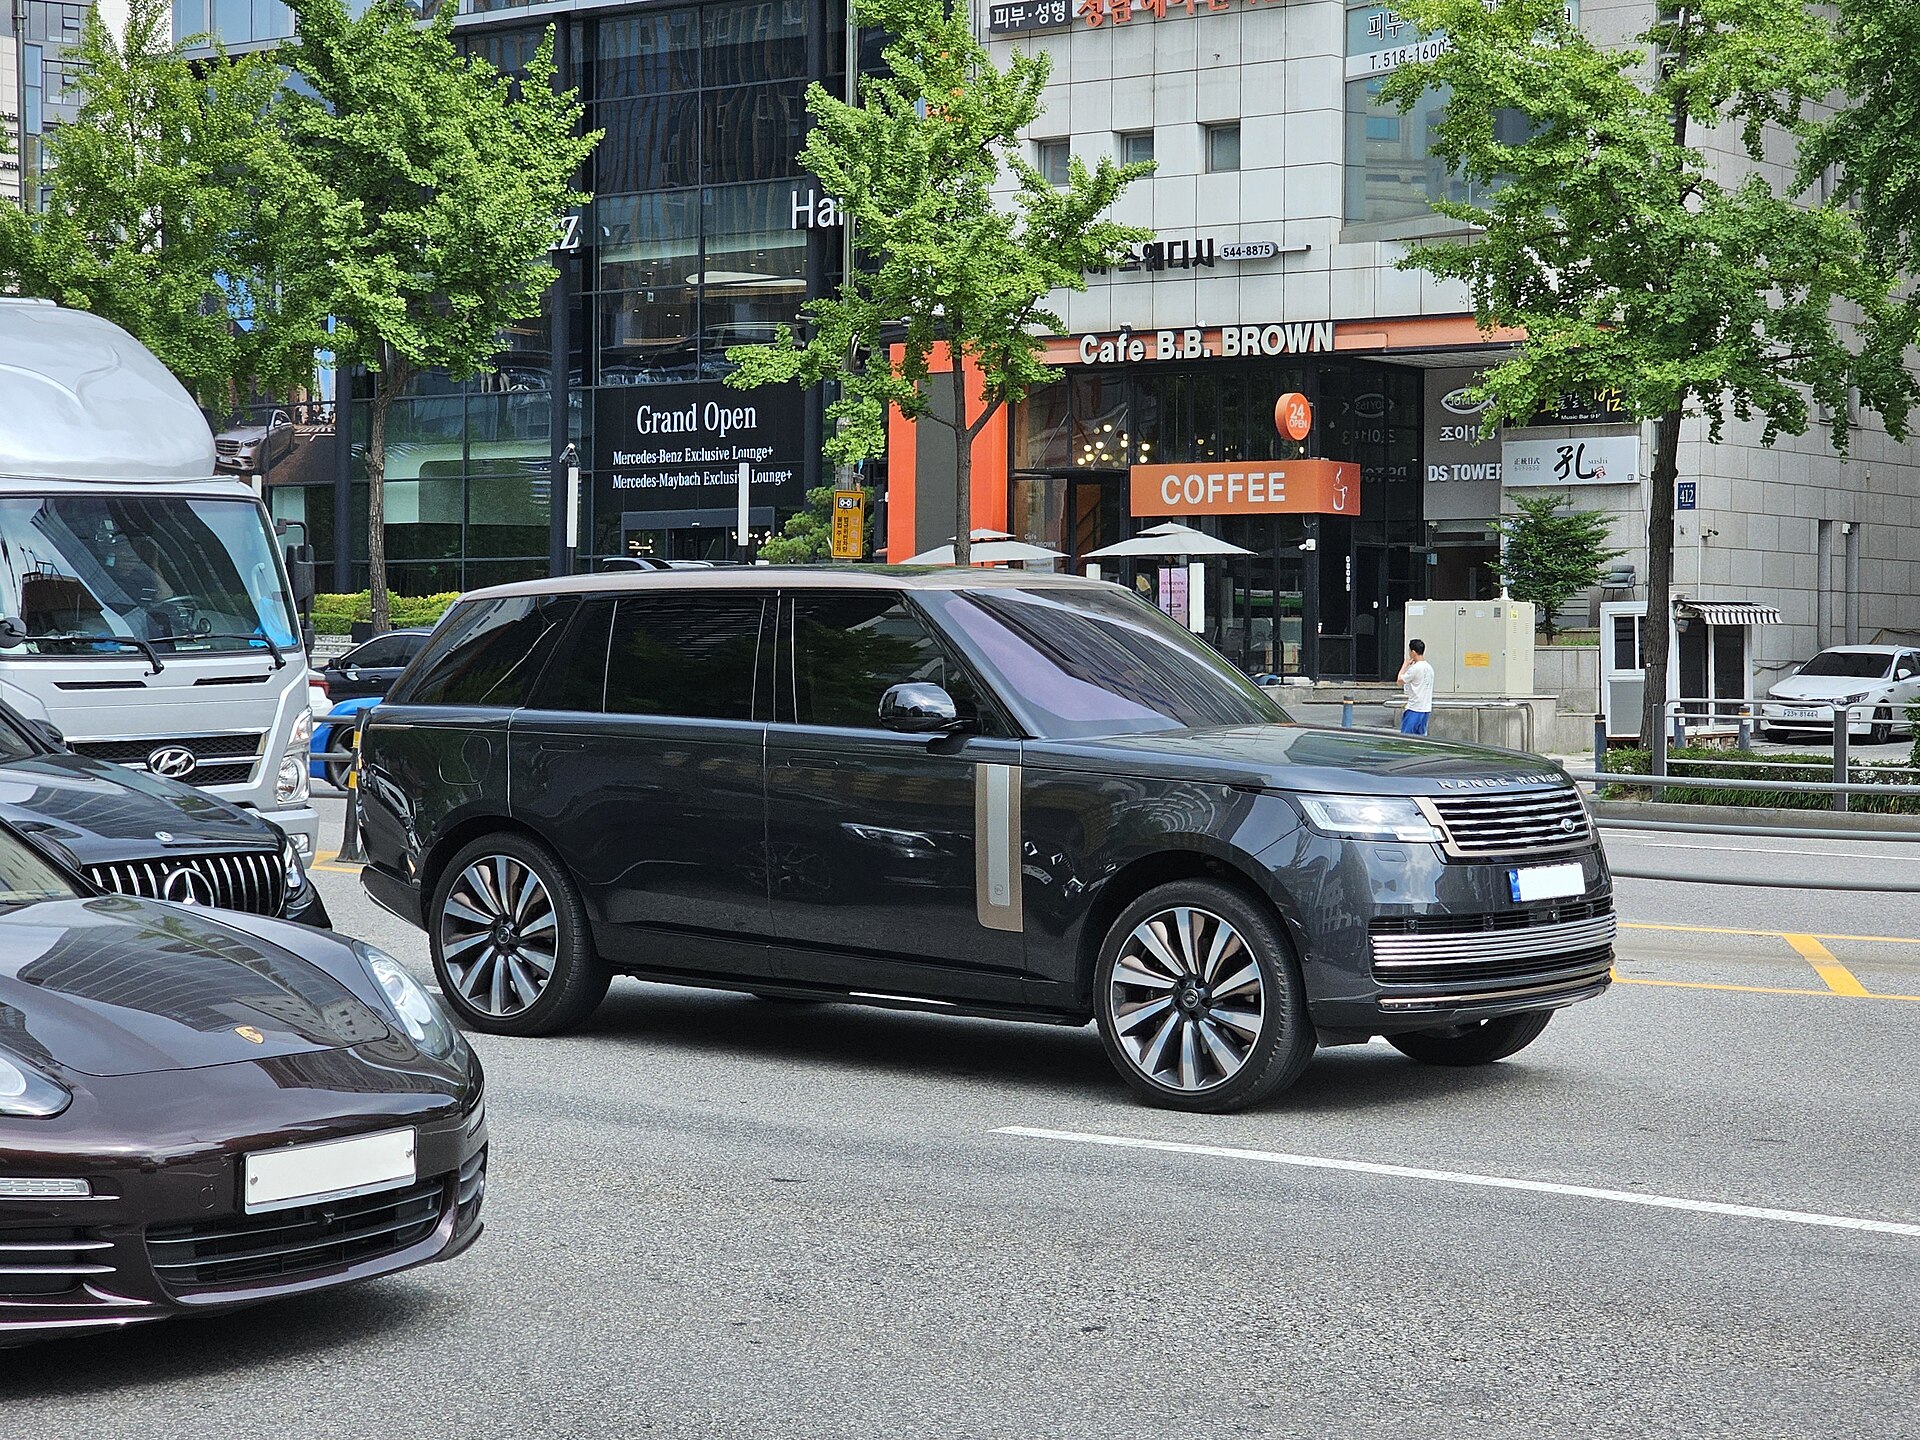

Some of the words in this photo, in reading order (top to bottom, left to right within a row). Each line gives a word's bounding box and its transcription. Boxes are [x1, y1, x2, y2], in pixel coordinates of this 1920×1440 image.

[994, 1, 1066, 29] 피부·성형
[1223, 245, 1270, 258] 544-8875
[1079, 333, 1146, 365] Cafe
[1156, 329, 1211, 360] B.B.
[1222, 321, 1334, 357] BROWN
[636, 402, 698, 435] Grand
[703, 401, 758, 438] Open
[1290, 403, 1305, 419] 24
[1289, 419, 1308, 428] OPEN
[612, 449, 683, 466] Mercedes-Benz
[684, 446, 730, 462] Exclusive
[612, 472, 701, 490] Mercedes-Maybach
[703, 470, 739, 486] Exclusi
[751, 469, 793, 486] Lounge+
[1428, 464, 1449, 482] DS
[1161, 472, 1286, 505] COFFEE
[1679, 489, 1694, 503] 412
[1437, 778, 1510, 789] RANGE
